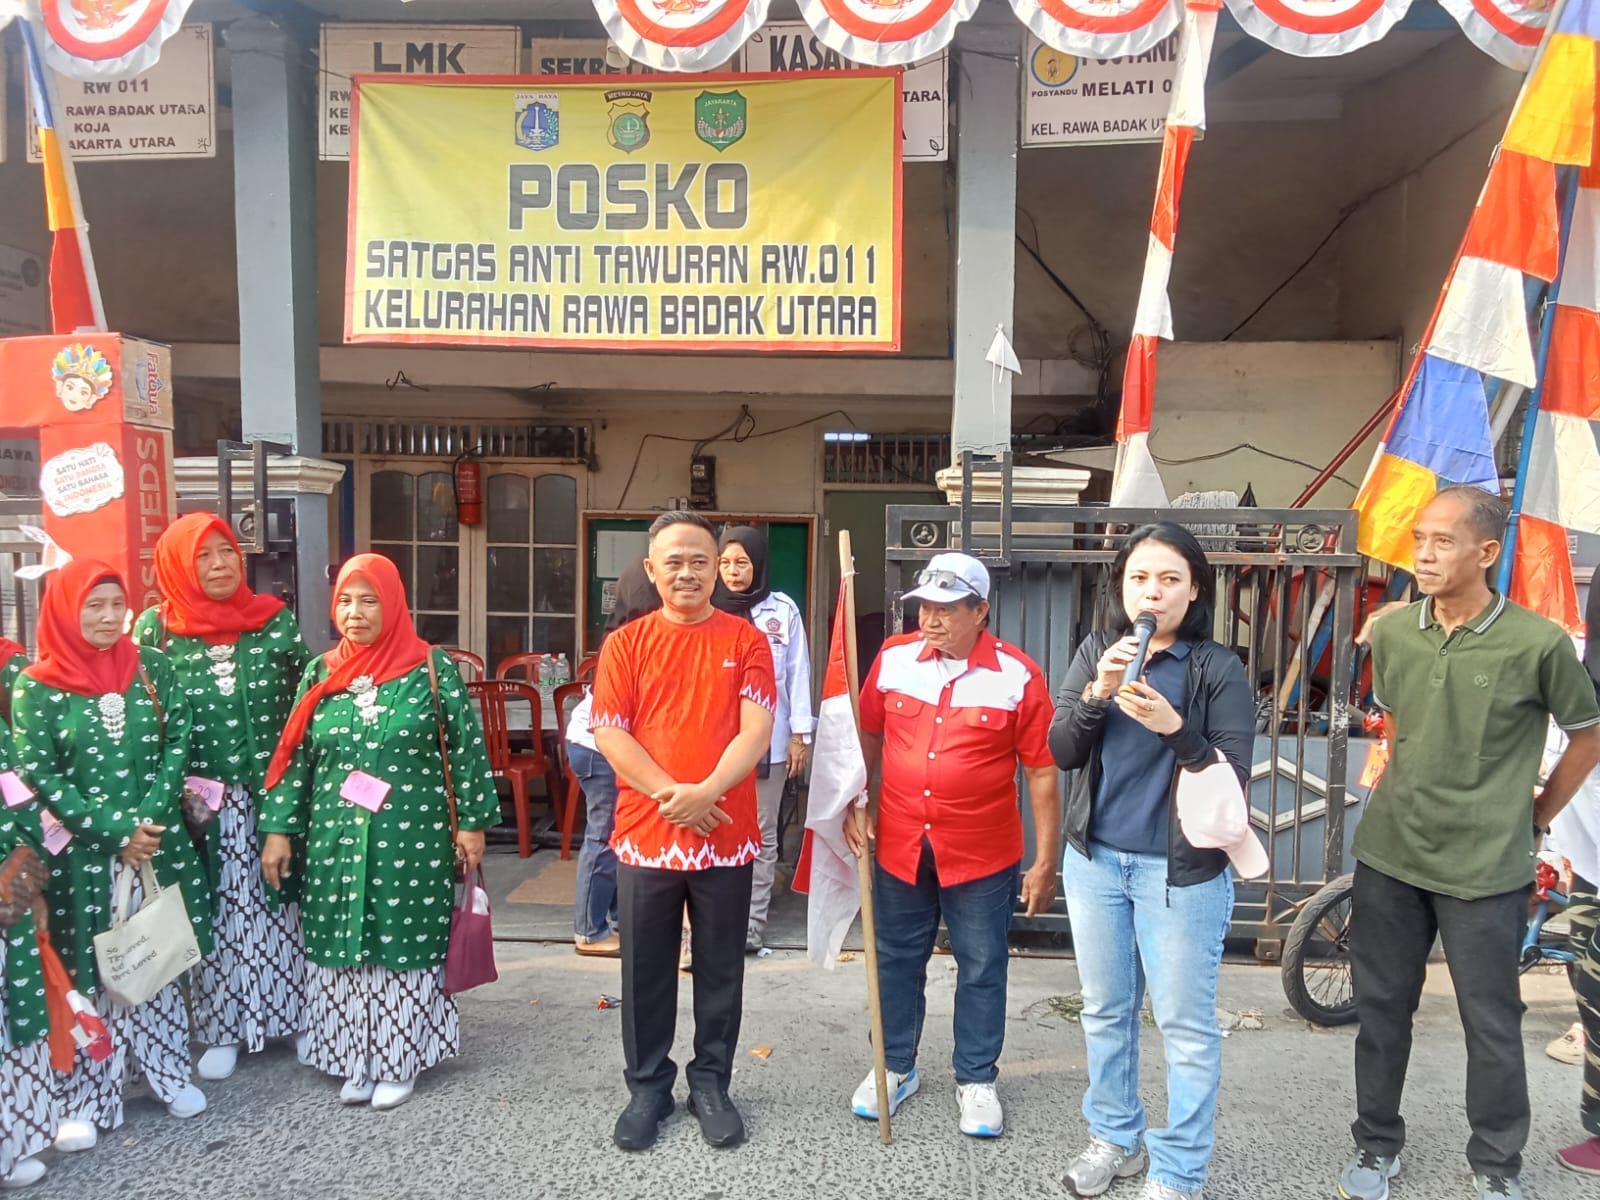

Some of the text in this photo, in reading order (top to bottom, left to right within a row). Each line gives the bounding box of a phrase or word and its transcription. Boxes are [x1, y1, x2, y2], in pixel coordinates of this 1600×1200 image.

[374, 42, 466, 73] LMK
[83, 78, 149, 94] RW 011
[1032, 89, 1078, 97] POSYANDU
[1082, 80, 1154, 97] MELATI
[66, 104, 206, 116] RAWA BADAK UTARA
[74, 122, 111, 133] KOJA
[1032, 123, 1059, 136] KEL.
[1063, 121, 1099, 134] RAWA
[1103, 119, 1147, 133] BADAK
[129, 136, 176, 148] UTARA
[508, 162, 748, 231] POSKO
[366, 240, 496, 281] SATGAS
[509, 244, 581, 283] ANTI
[594, 244, 748, 284] TAWURAN
[364, 289, 876, 335] KELURAHAN RAWA BADAK UTARA
